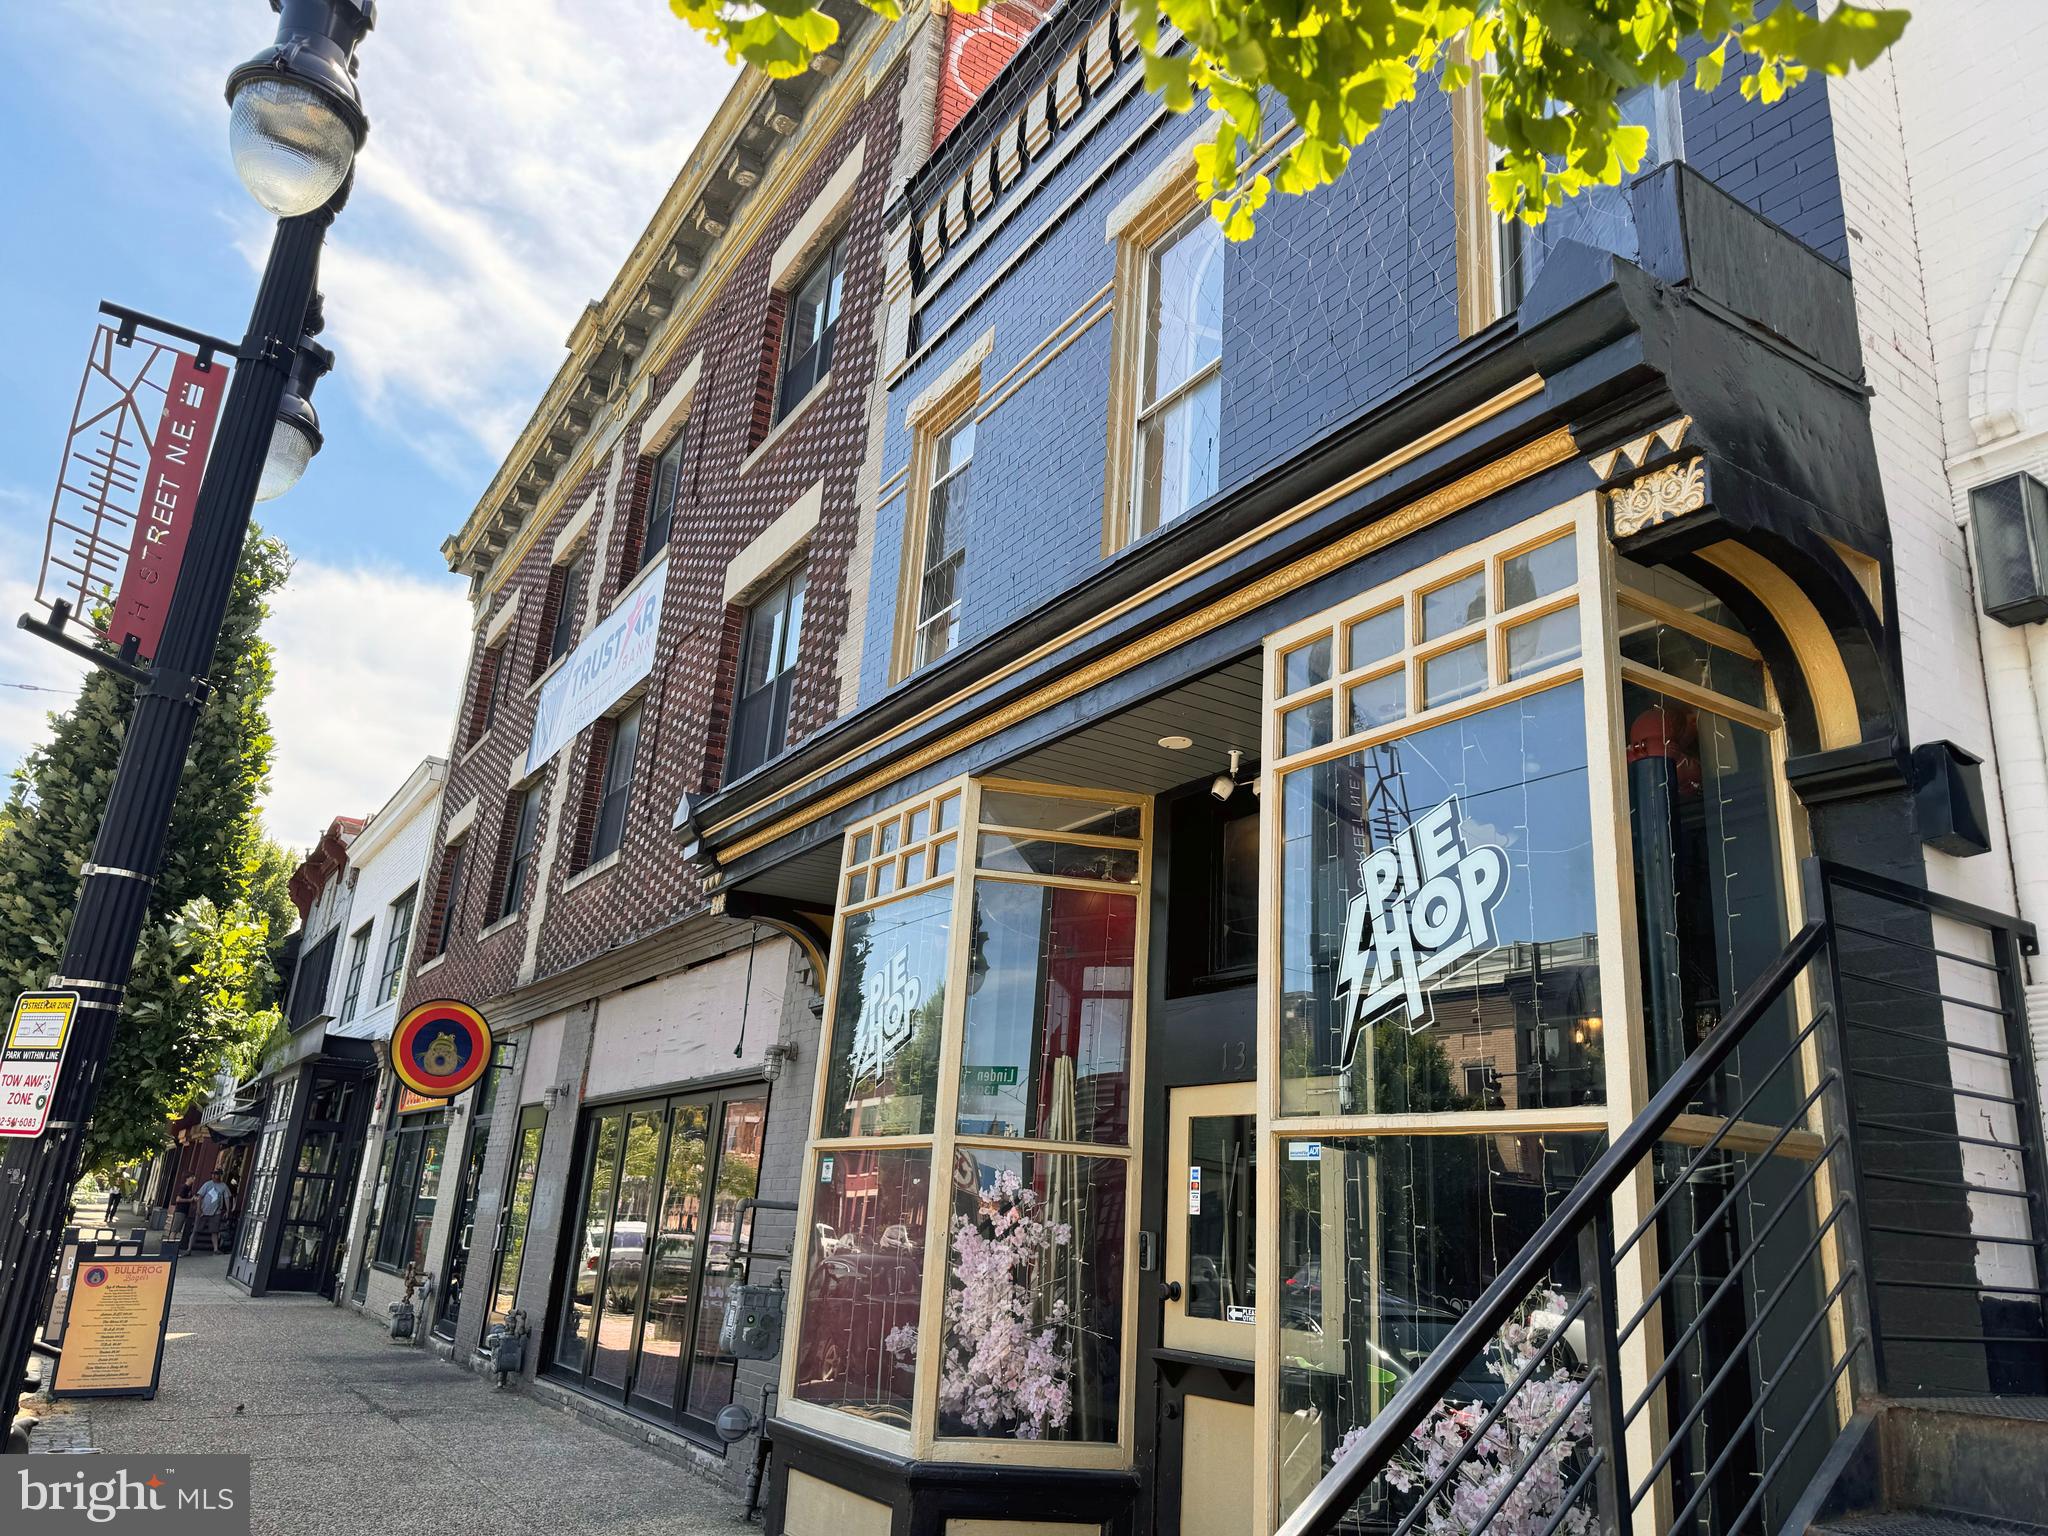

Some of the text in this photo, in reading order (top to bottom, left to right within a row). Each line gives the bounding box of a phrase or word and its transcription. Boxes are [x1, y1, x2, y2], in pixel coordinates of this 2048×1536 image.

[128, 419, 197, 621] H STREET N.E.
[1362, 800, 1461, 908] PIE
[869, 944, 909, 1007] PIE
[58, 1001, 72, 1009] ZONE
[5, 1051, 60, 1060] PARK WITHIN LINE
[2, 1074, 23, 1087] TOW
[7, 1092, 33, 1105] ZONE
[115, 1266, 163, 1275] BULLFROG
